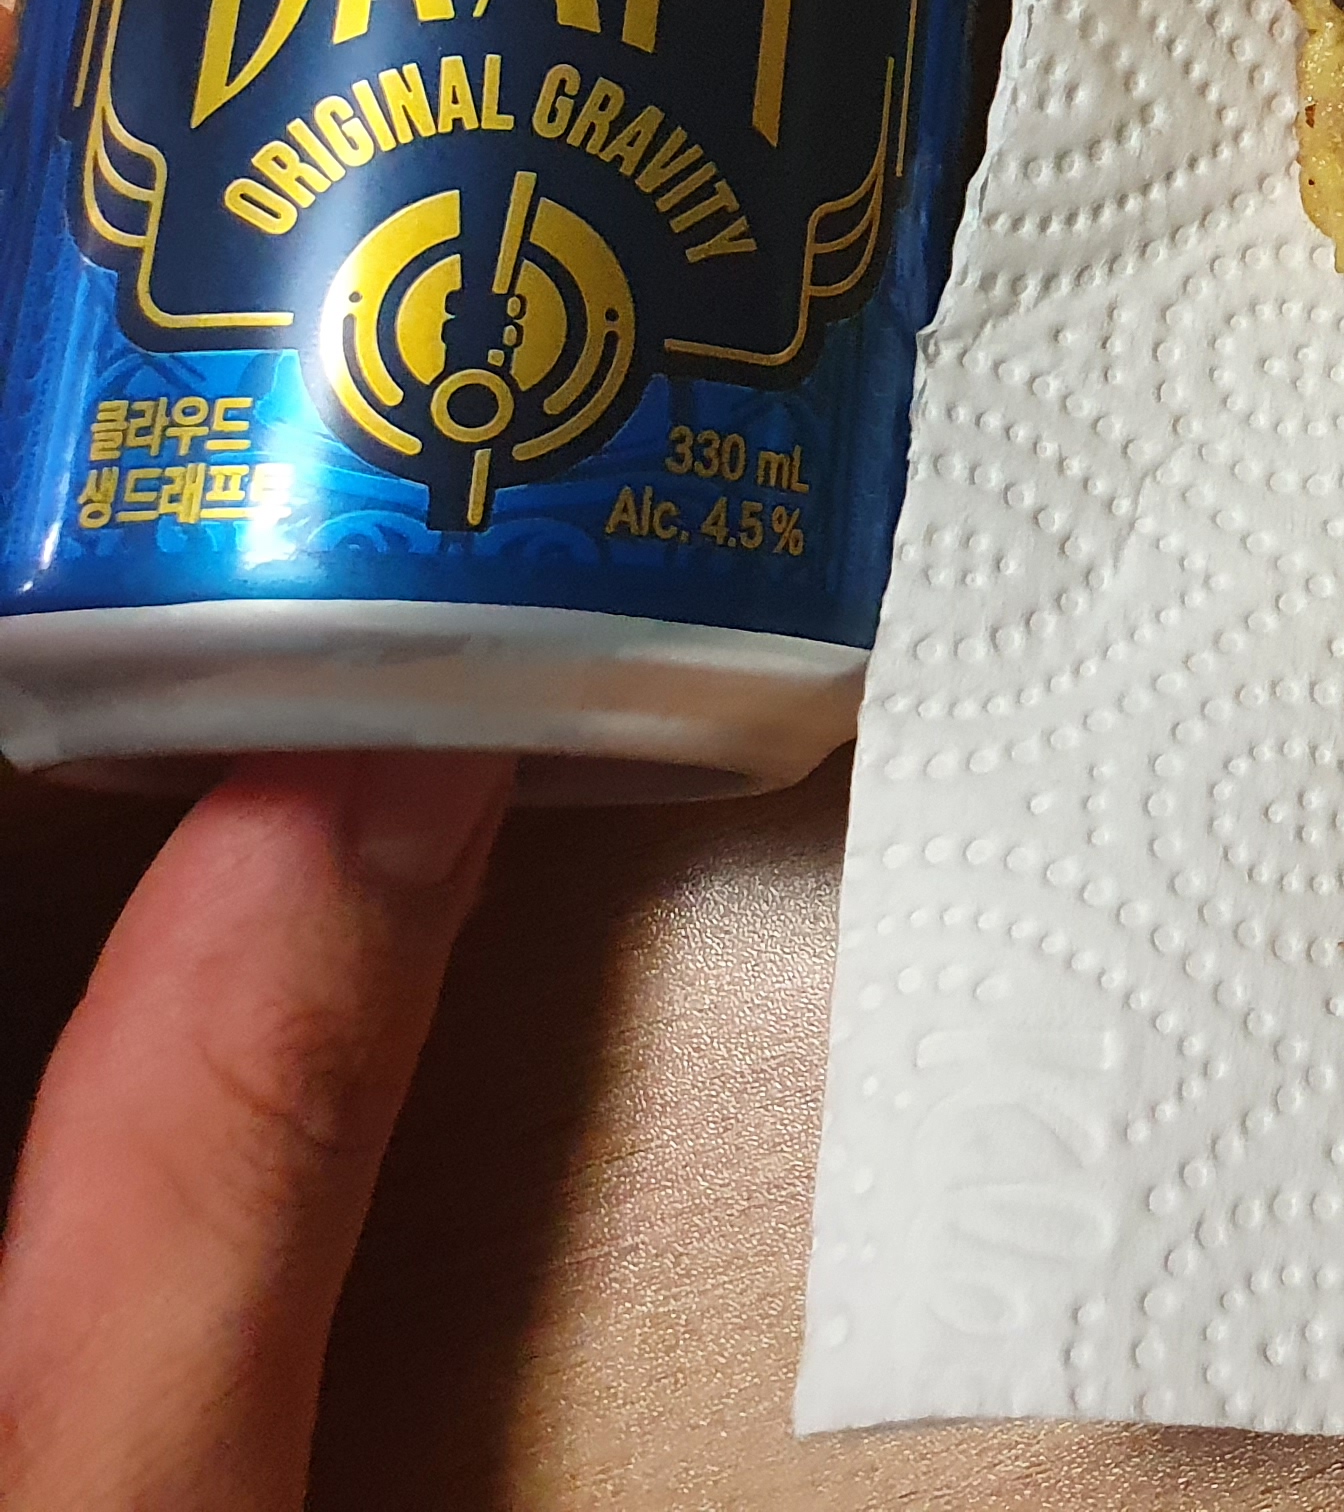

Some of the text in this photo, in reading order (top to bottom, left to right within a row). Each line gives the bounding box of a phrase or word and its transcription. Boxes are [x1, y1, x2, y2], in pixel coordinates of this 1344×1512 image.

[223, 53, 758, 264] ORIGINAL GRAVITY
[89, 395, 254, 462] 클라우드
[664, 424, 747, 481] 330
[604, 485, 690, 544] Alc.
